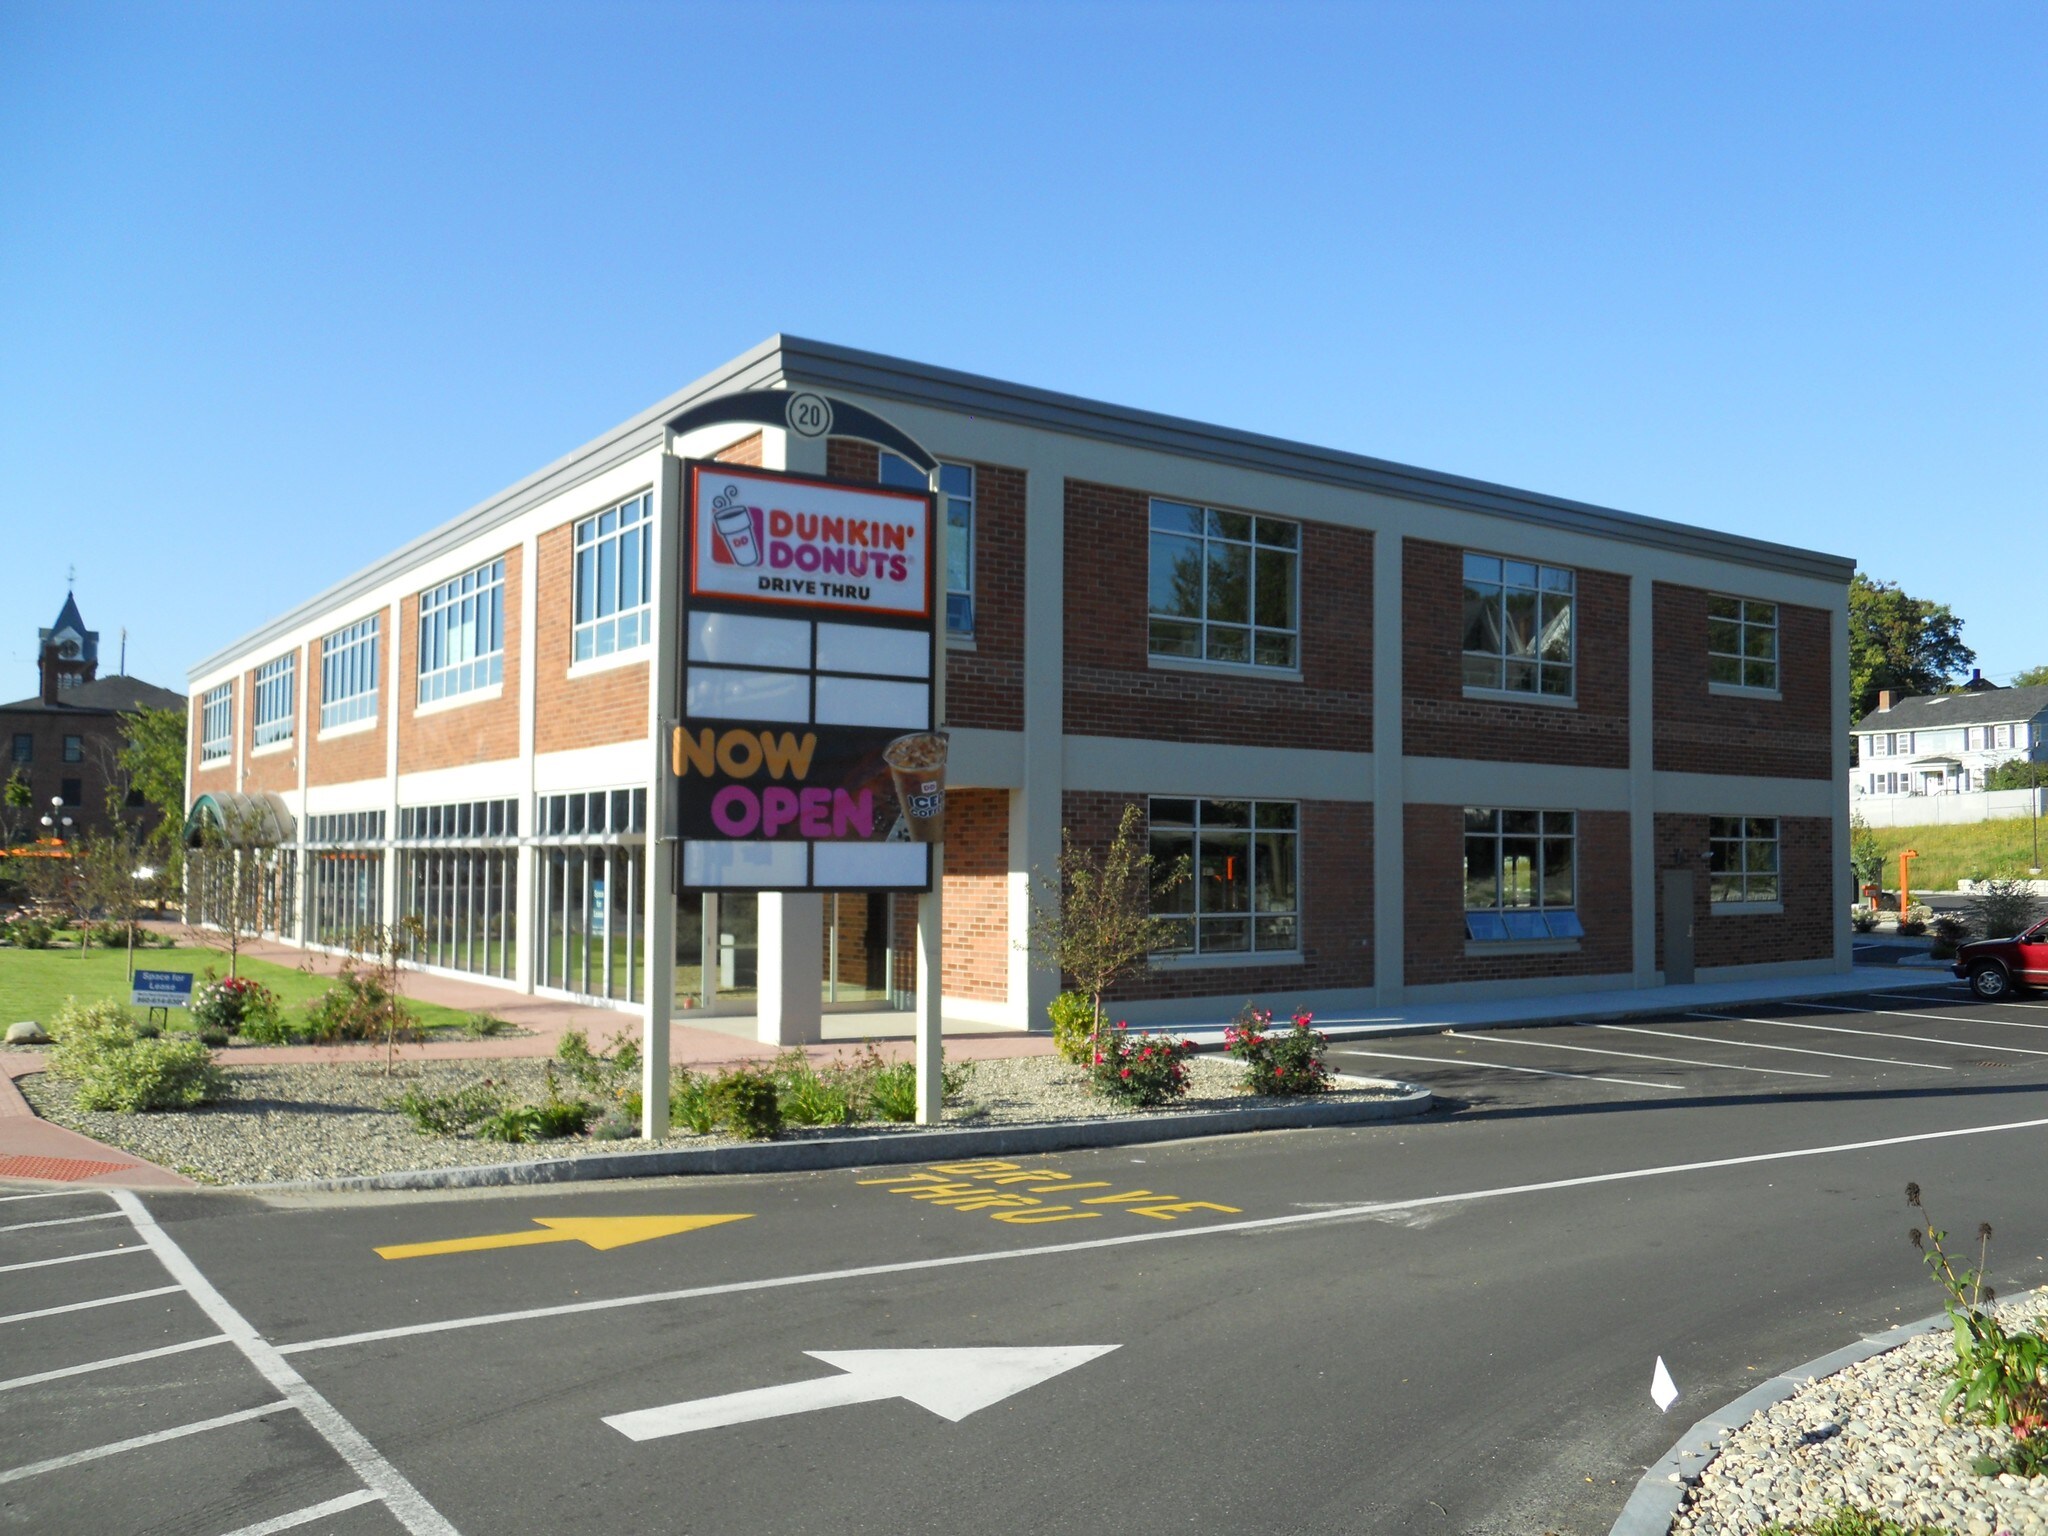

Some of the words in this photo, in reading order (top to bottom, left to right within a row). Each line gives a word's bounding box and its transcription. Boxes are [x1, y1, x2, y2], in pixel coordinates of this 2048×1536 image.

[798, 403, 820, 427] 20
[769, 509, 914, 551] DUNKIN'
[769, 541, 908, 582] DONUTS
[758, 575, 816, 595] DRIVE
[820, 582, 870, 601] THRU
[672, 726, 817, 781] NOW
[710, 784, 873, 838] OPEN
[142, 972, 170, 981] Space
[172, 974, 185, 982] for
[149, 982, 176, 990] Lease
[855, 1173, 1102, 1224] THRU
[928, 1161, 1243, 1220] DRIVE
